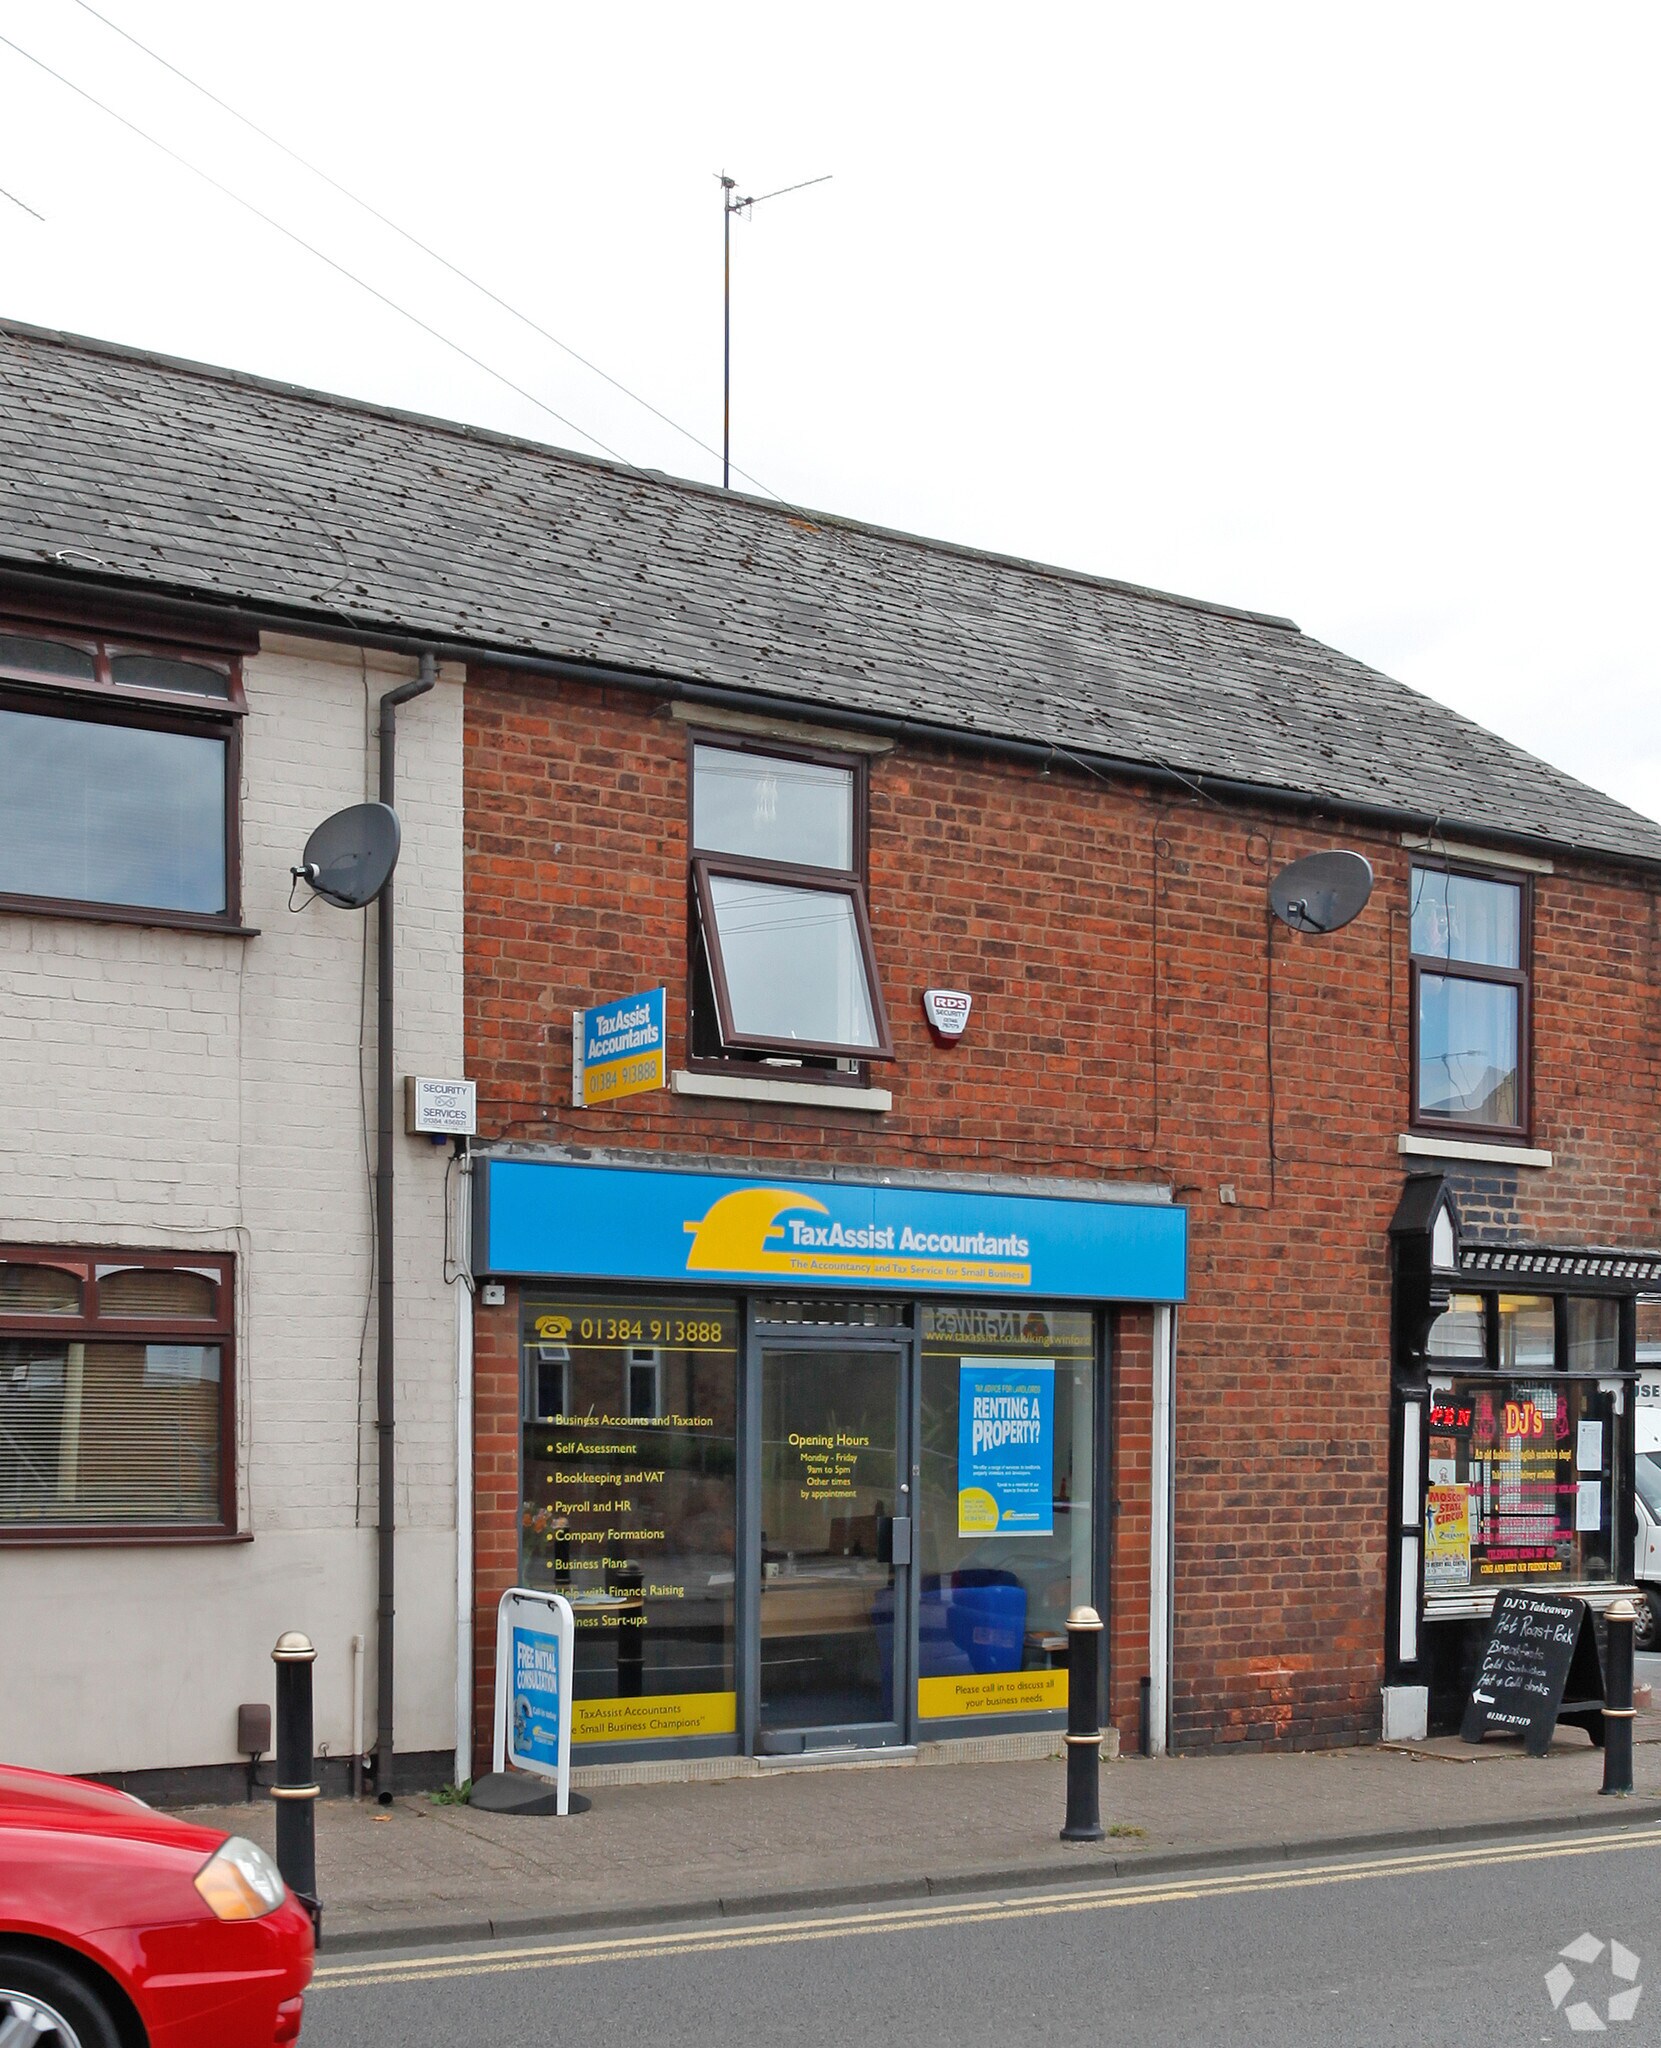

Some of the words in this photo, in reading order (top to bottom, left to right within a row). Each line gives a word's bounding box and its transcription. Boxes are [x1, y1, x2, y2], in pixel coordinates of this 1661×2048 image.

[935, 997, 966, 1009] RDS
[596, 1003, 651, 1036] TaxAssist
[935, 1009, 965, 1017] SECURITY
[588, 1024, 659, 1059] Accountants
[590, 1071, 617, 1093] 01384
[622, 1060, 657, 1084] 913888
[423, 1084, 467, 1095] SECURITY
[423, 1108, 467, 1119] SERVICES
[788, 1221, 895, 1249] TaxAssist
[899, 1227, 1029, 1257] Accountants
[790, 1259, 808, 1269] The
[810, 1260, 871, 1274] Accountancy
[874, 1263, 891, 1273] and
[892, 1264, 907, 1273] Tax
[911, 1265, 943, 1275] Service
[946, 1266, 958, 1276] for
[961, 1267, 985, 1277] Small
[988, 1269, 1024, 1279] Business
[580, 1318, 643, 1340] 01384
[650, 1320, 722, 1342] 913888
[925, 1331, 1091, 1347] www.taxassist.co.uk/kingswinford
[973, 1397, 1028, 1419] RENTING
[1031, 1398, 1040, 1419] A
[556, 1414, 599, 1426] Business
[601, 1414, 649, 1426] Accounts
[652, 1414, 670, 1426] and
[672, 1415, 713, 1426] Taxation
[1430, 1405, 1471, 1427] PEN
[1505, 1402, 1543, 1436] DJ's
[788, 1433, 834, 1449] Opening
[836, 1433, 869, 1446] Hours
[972, 1420, 1040, 1456] PROPERTY?
[555, 1443, 576, 1454] Self
[576, 1443, 637, 1454] Assessment
[800, 1453, 829, 1463] Monday
[836, 1453, 857, 1463] Friday
[807, 1465, 823, 1474] 9am
[824, 1466, 833, 1474] to
[835, 1465, 851, 1475] 5pm
[555, 1472, 622, 1486] Bookkeeping
[624, 1472, 643, 1483] and
[644, 1471, 665, 1482] VAT
[806, 1477, 829, 1486] Other
[831, 1478, 851, 1486] times
[800, 1489, 809, 1500] by
[811, 1490, 857, 1500] appointment
[1429, 1492, 1467, 1502] MOSCOW
[555, 1501, 591, 1515] Payroll
[593, 1501, 611, 1512] and
[615, 1501, 632, 1512] HR
[1439, 1502, 1461, 1513] STATE
[1435, 1511, 1464, 1525] CIRCUS
[555, 1530, 605, 1543] Company
[608, 1529, 665, 1540] Formations
[555, 1559, 598, 1570] Business
[602, 1558, 628, 1569] Plans
[555, 1588, 580, 1600] Help
[583, 1587, 606, 1598] with
[609, 1586, 647, 1597] Finance
[650, 1585, 684, 1597] Raising
[1503, 1597, 1528, 1610] DJ'S
[1529, 1601, 1573, 1618] Takeaway
[575, 1617, 599, 1627] ness
[601, 1614, 648, 1627] Start-ups
[1495, 1612, 1518, 1634] Hot
[1520, 1615, 1553, 1640] Roast
[1553, 1624, 1574, 1645] Pork
[517, 1641, 535, 1669] FREE
[535, 1649, 556, 1673] INITIAL
[1482, 1657, 1504, 1671] Cold
[517, 1669, 558, 1694] CONSULTATION
[955, 1685, 979, 1695] Please
[982, 1683, 995, 1693] call
[997, 1683, 1004, 1692] in
[1006, 1683, 1015, 1691] to
[1017, 1681, 1044, 1690] discuss
[1046, 1679, 1055, 1688] all
[1477, 1672, 1497, 1687] Hot
[1504, 1676, 1523, 1687] Cold
[965, 1699, 983, 1710] your
[986, 1695, 1018, 1706] business
[579, 1708, 622, 1719] TaxAssist
[624, 1705, 682, 1717] Accountants
[580, 1722, 605, 1734] Small
[607, 1720, 646, 1732] Business
